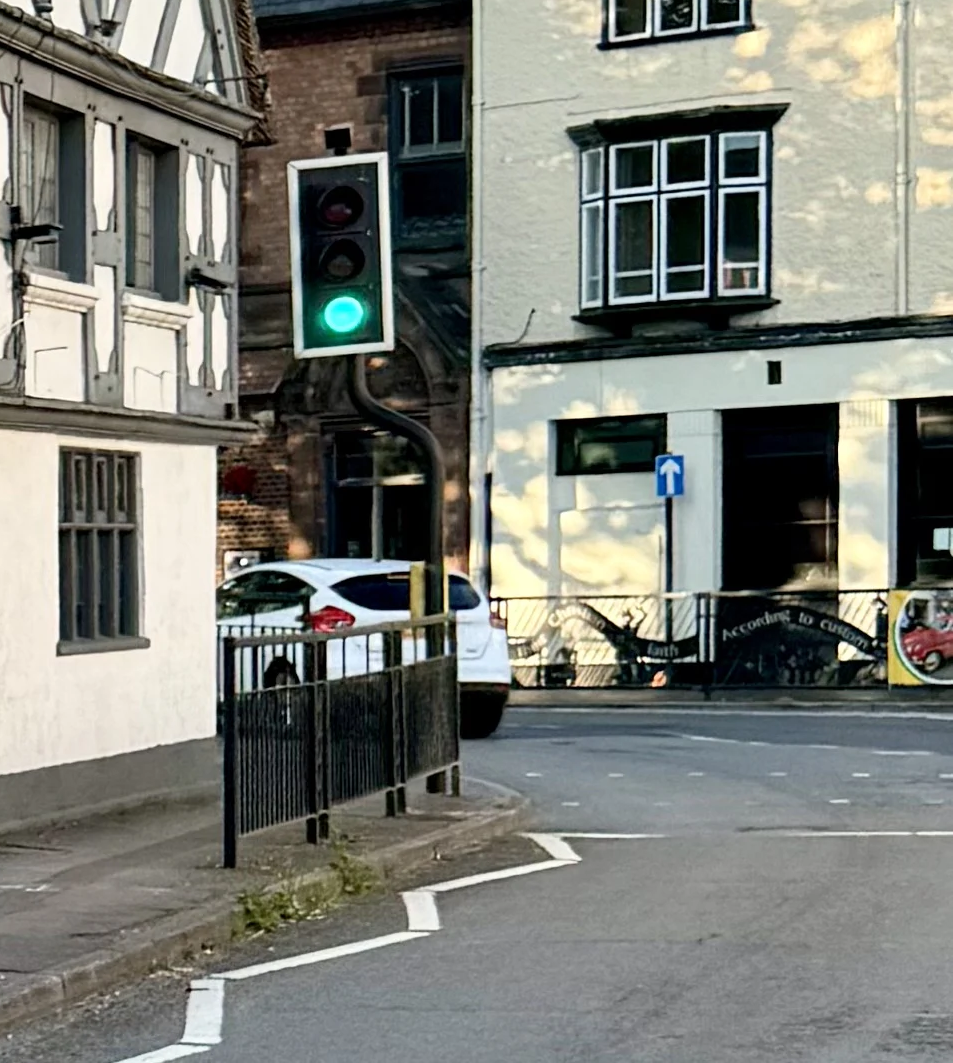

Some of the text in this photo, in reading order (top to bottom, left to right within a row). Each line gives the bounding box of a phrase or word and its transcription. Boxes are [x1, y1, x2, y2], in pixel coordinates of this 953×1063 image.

[722, 610, 869, 650] According to custom
